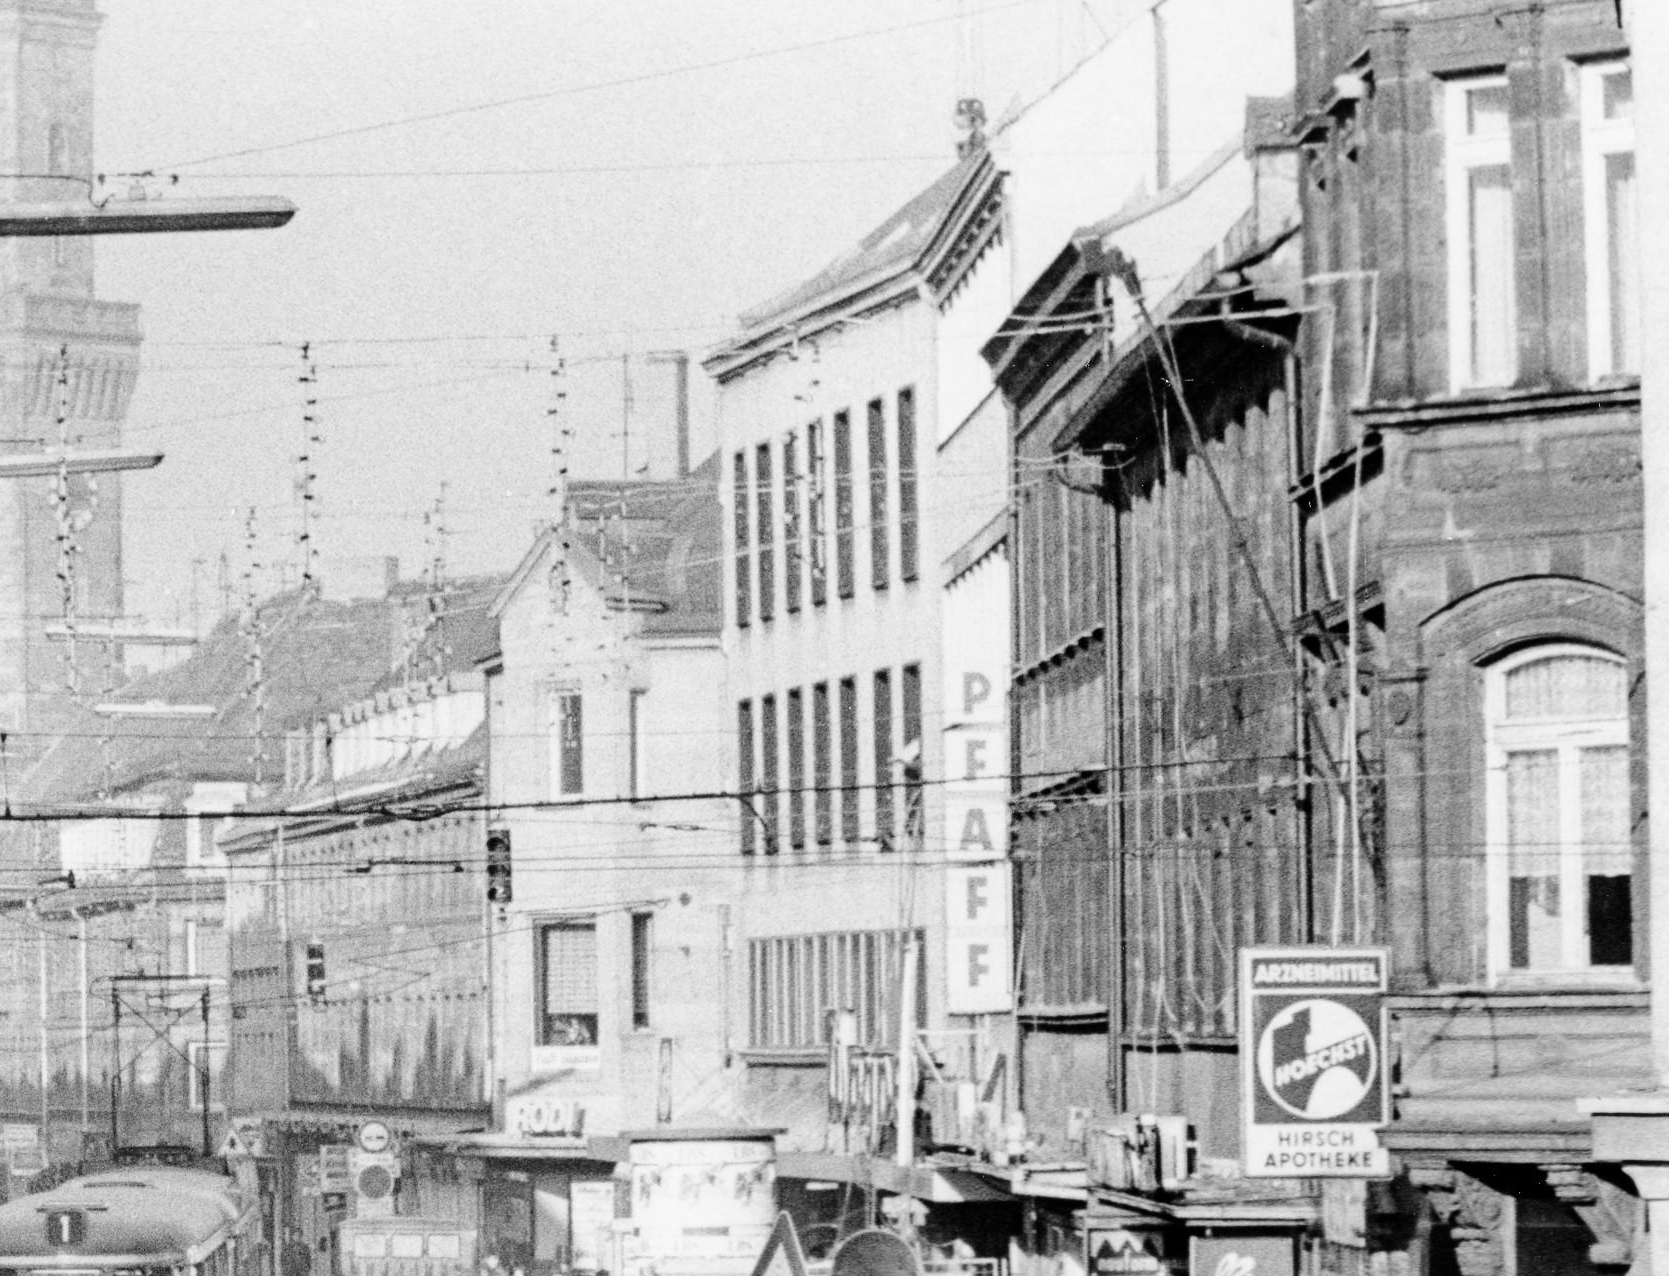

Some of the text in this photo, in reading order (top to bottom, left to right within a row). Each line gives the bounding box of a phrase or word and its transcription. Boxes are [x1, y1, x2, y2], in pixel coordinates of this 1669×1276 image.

[960, 672, 993, 987] PFAFF
[1254, 963, 1379, 983] ARZNEIMITTEL
[1275, 1037, 1367, 1086] HOECHST
[1278, 1131, 1354, 1147] HIRSCH
[1265, 1152, 1373, 1168] APOTHEKE
[59, 1216, 70, 1243] 1
